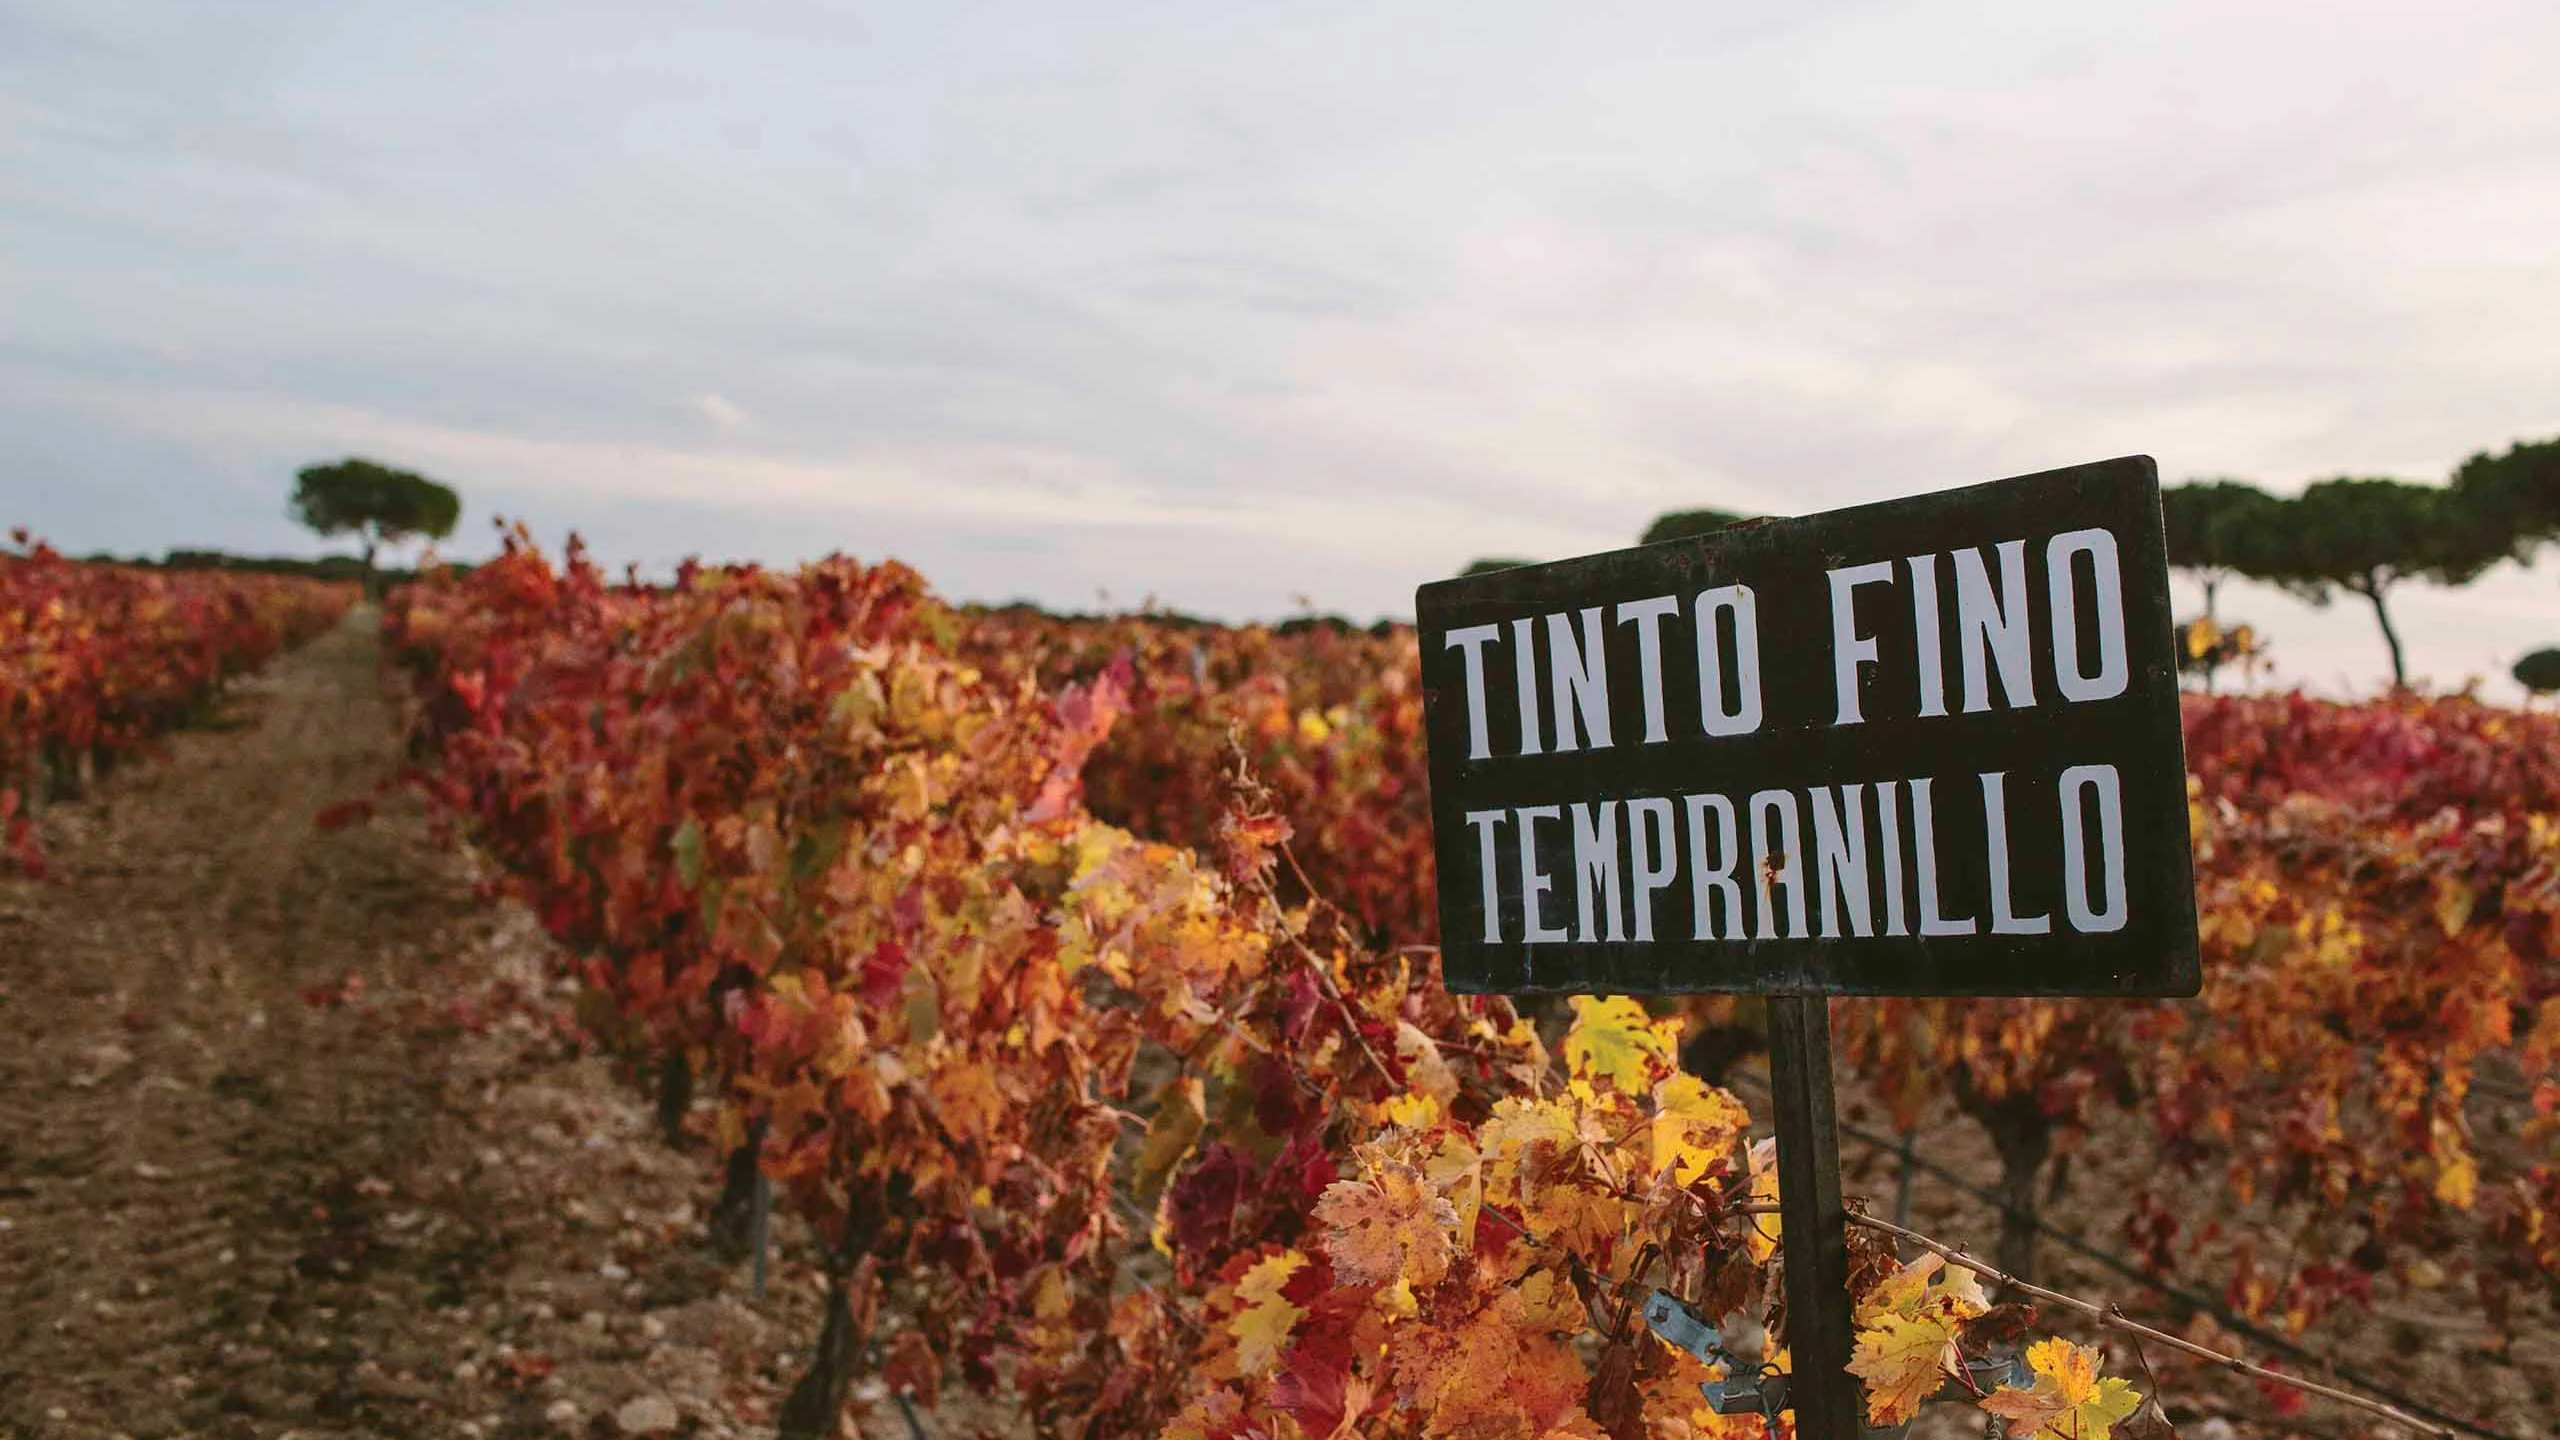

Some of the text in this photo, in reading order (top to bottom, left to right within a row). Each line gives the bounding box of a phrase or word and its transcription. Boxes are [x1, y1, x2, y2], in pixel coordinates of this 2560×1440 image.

[1444, 527, 2129, 760] TINTO FINO
[1465, 764, 2128, 944] TEMPRANILLO
